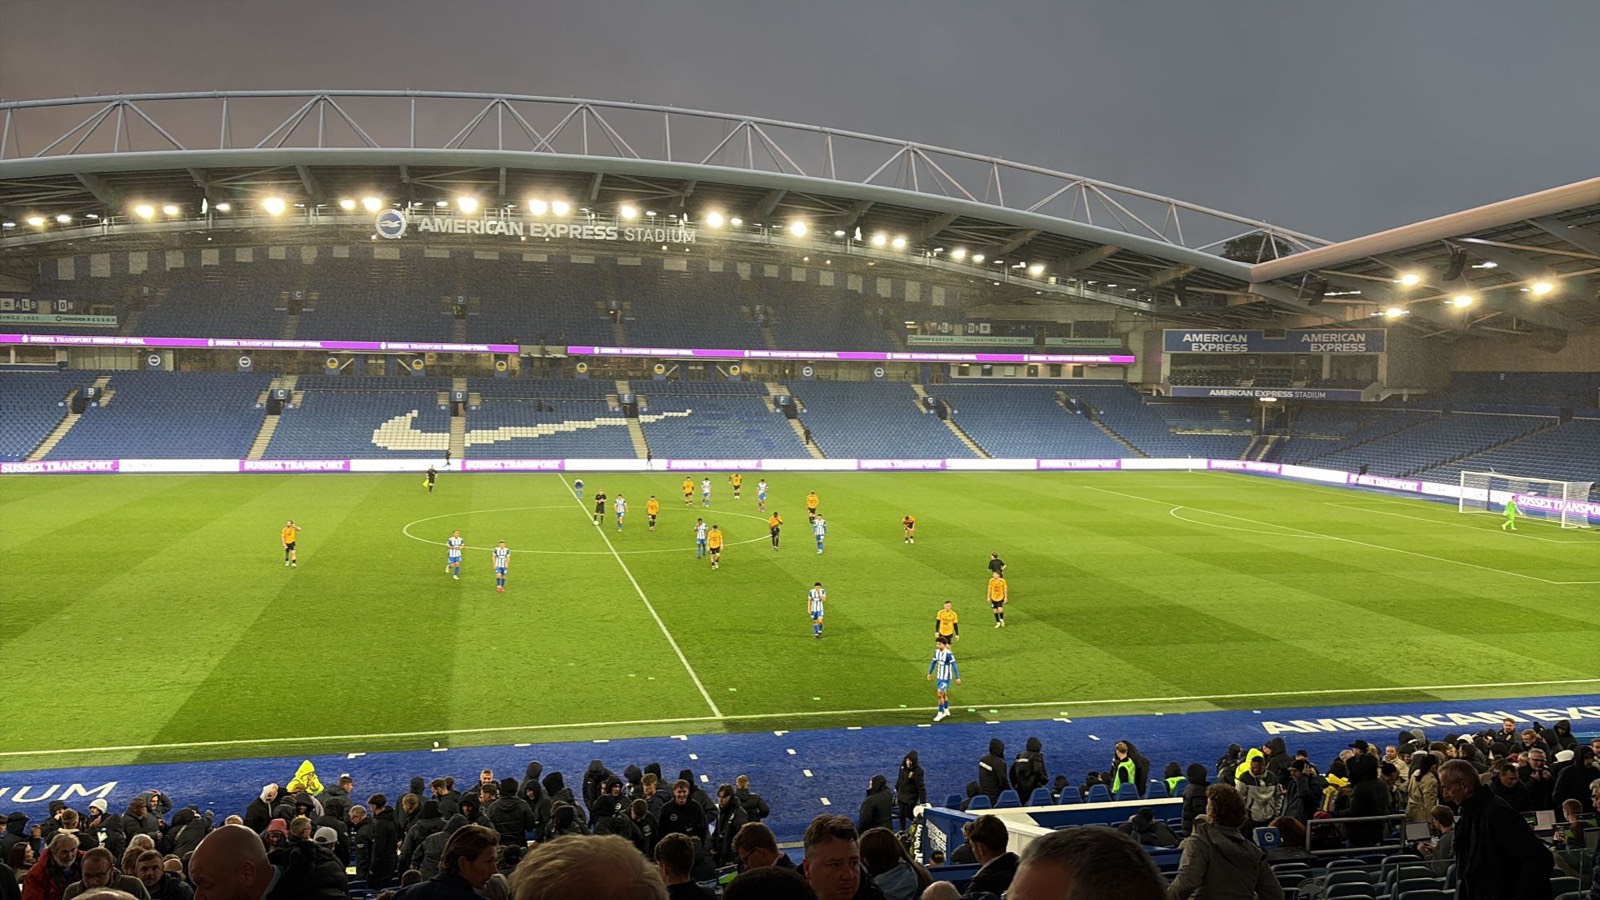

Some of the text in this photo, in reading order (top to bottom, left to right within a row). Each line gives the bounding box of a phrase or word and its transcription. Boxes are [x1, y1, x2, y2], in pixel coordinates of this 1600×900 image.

[418, 218, 524, 236] AMERICAN
[529, 223, 618, 240] EXPRESS
[625, 228, 696, 243] STADIUM
[1182, 333, 1247, 343] AMERICAN
[1301, 333, 1365, 342] AMERICAN
[1191, 343, 1248, 352] EXPRESS
[1310, 343, 1366, 352] EXPRESS
[1254, 390, 1294, 398] EXPRESS
[1294, 390, 1326, 398] STADIUM
[1, 460, 113, 472] SUSSEX TRANSPORT
[1517, 495, 1552, 508] SUSSEX
[1262, 709, 1530, 735] AMERICAN
